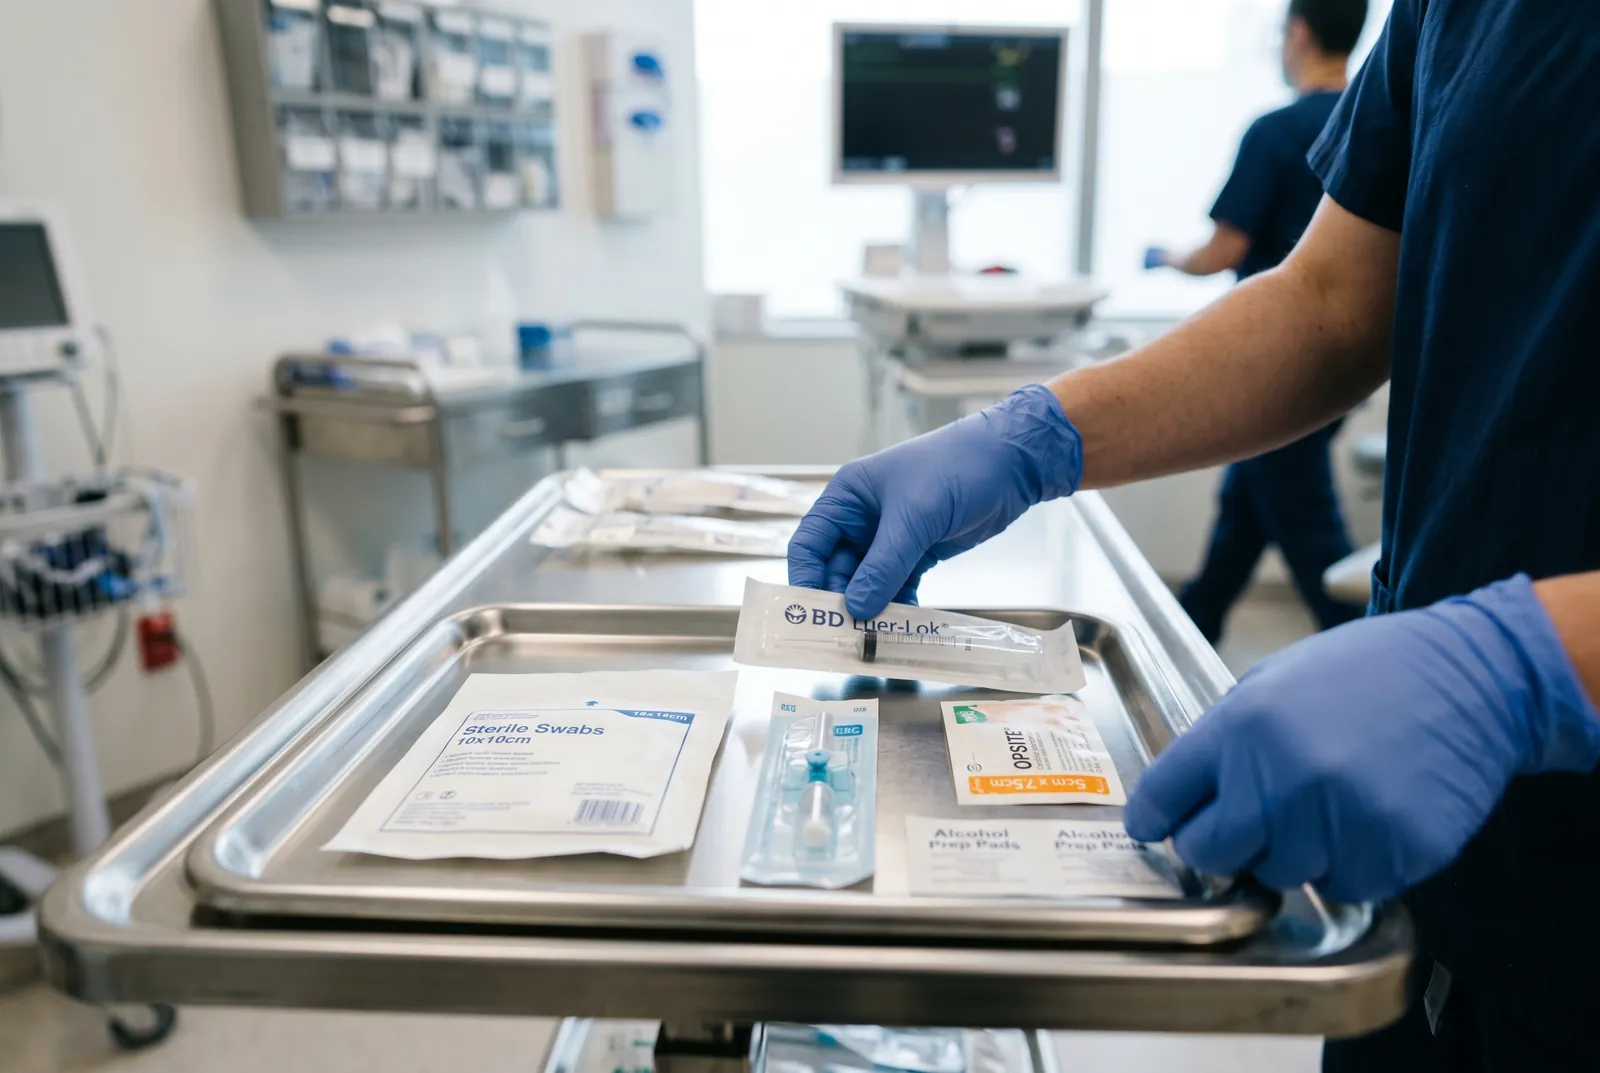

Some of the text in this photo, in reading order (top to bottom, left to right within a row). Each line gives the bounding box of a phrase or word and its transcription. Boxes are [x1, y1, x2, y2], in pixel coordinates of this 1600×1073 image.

[812, 609, 845, 628] BD
[463, 723, 605, 736] Sterile Swabs
[457, 736, 532, 746] 10x10cm
[989, 778, 1087, 790] 5cm x 7.5cm
[934, 828, 1010, 839] Alcohol
[1058, 829, 1128, 841] Alcoho
[929, 839, 1021, 852] Prep Pads
[1054, 840, 1098, 852] Prep
